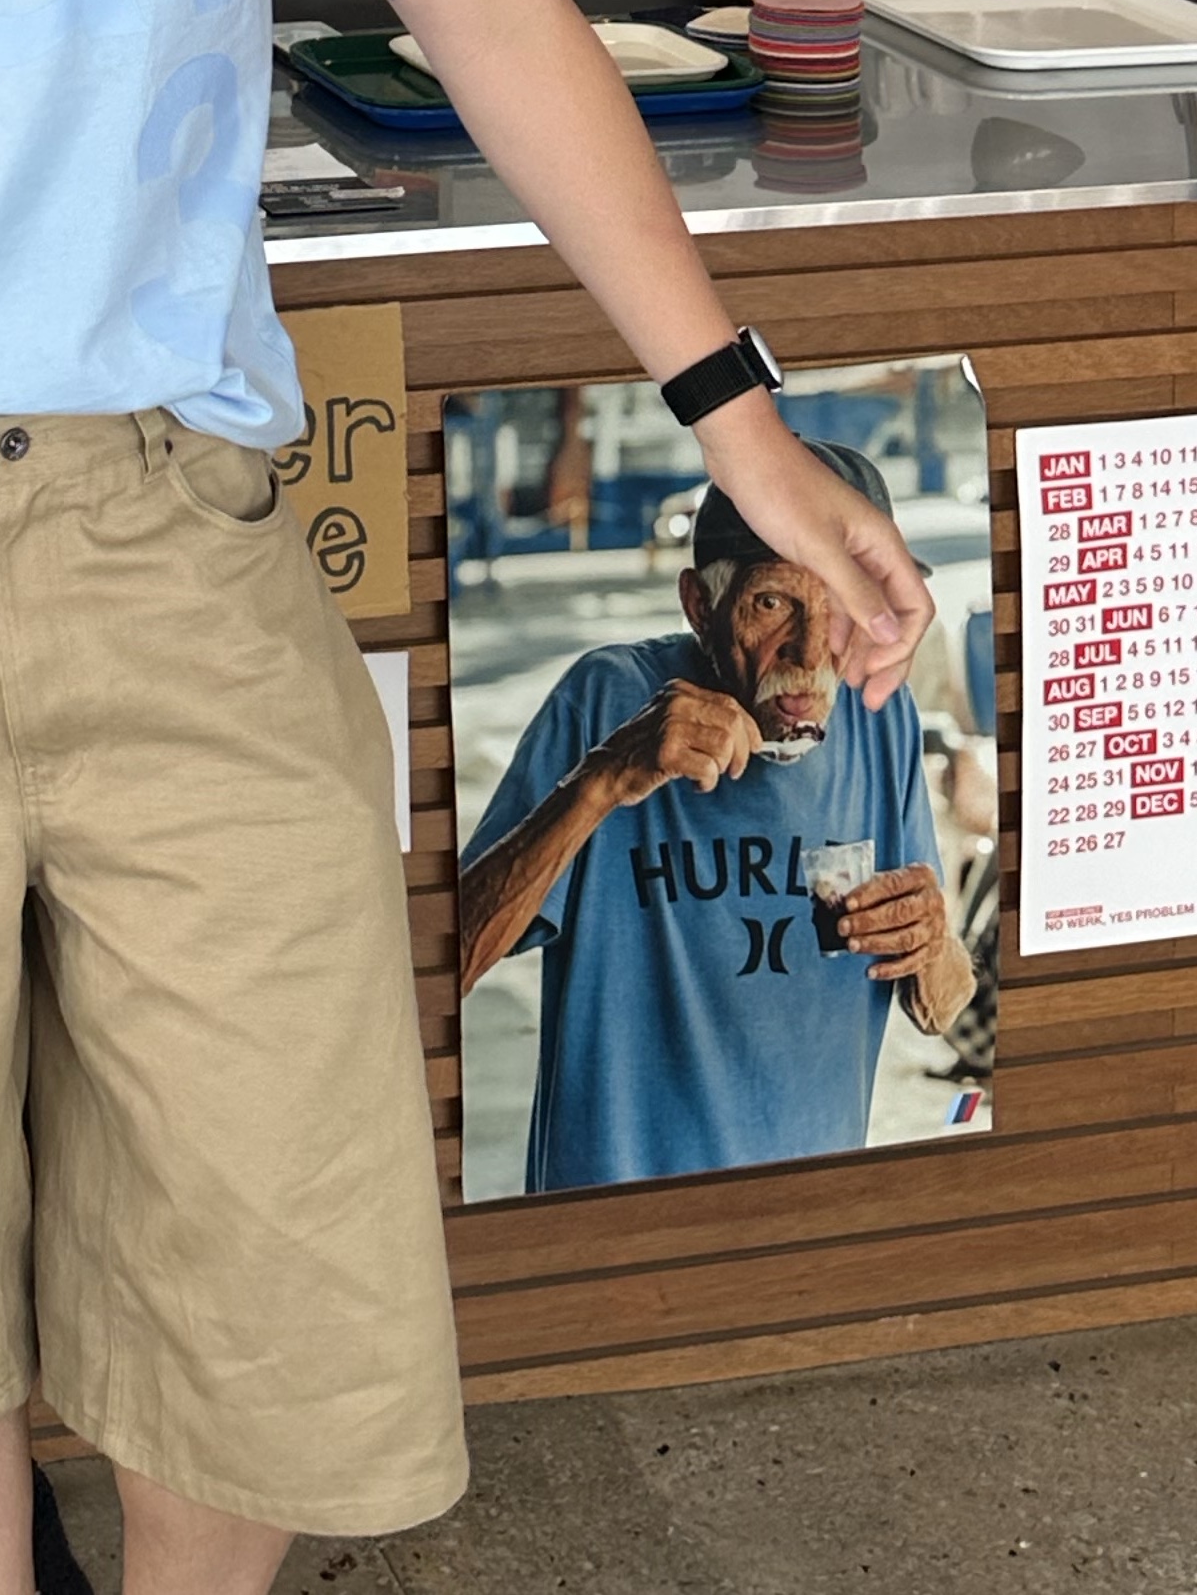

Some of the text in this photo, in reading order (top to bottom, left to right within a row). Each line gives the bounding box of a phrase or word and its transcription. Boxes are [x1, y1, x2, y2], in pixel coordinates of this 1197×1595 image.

[1044, 456, 1085, 477] JAN
[1098, 455, 1106, 470] 1
[1114, 452, 1126, 469] 3
[1132, 451, 1143, 467] 4
[1150, 448, 1172, 465] 10
[1047, 488, 1087, 510] FEB
[1099, 487, 1108, 503] 1
[1115, 485, 1126, 501] 7
[1132, 482, 1143, 499] 8
[1150, 480, 1171, 497] 14
[1048, 523, 1071, 541] 28
[1082, 515, 1127, 538] MAR
[1139, 513, 1147, 530] 1
[1155, 512, 1166, 529] 2
[1172, 510, 1183, 527] 7
[307, 507, 367, 593] e
[1048, 542, 1189, 573] 29 APR 4 5 11
[1048, 573, 1193, 607] MAY 2 3 5 9 10
[1048, 605, 1186, 637] 30 31 JUN 6 7
[1048, 650, 1070, 669] 28
[1078, 642, 1117, 665] JUL
[1128, 641, 1139, 657] 4
[1144, 639, 1156, 656] 5
[1162, 637, 1182, 653] 11
[1047, 668, 1190, 701] AUG 1 2 8 9 15
[1048, 713, 1070, 732] 30
[1078, 706, 1118, 728] SEP
[1128, 704, 1139, 721] 5
[1145, 702, 1156, 719] 6
[1163, 700, 1185, 717] 12
[1048, 730, 1190, 763] 26 27 OCT 3 4
[1048, 776, 1070, 795] 24
[1075, 772, 1098, 790] 25
[1103, 769, 1124, 786] 31
[1135, 761, 1179, 784] NOV
[1048, 807, 1070, 825] 22
[1075, 803, 1098, 822] 28
[1103, 800, 1126, 818] 29
[1135, 793, 1178, 815] DEC
[1048, 831, 1126, 857] 25 26 27
[630, 835, 844, 909] HURL
[1045, 920, 1063, 931] NO
[1109, 911, 1132, 924] YES
[1136, 903, 1194, 920] PROBLEM
